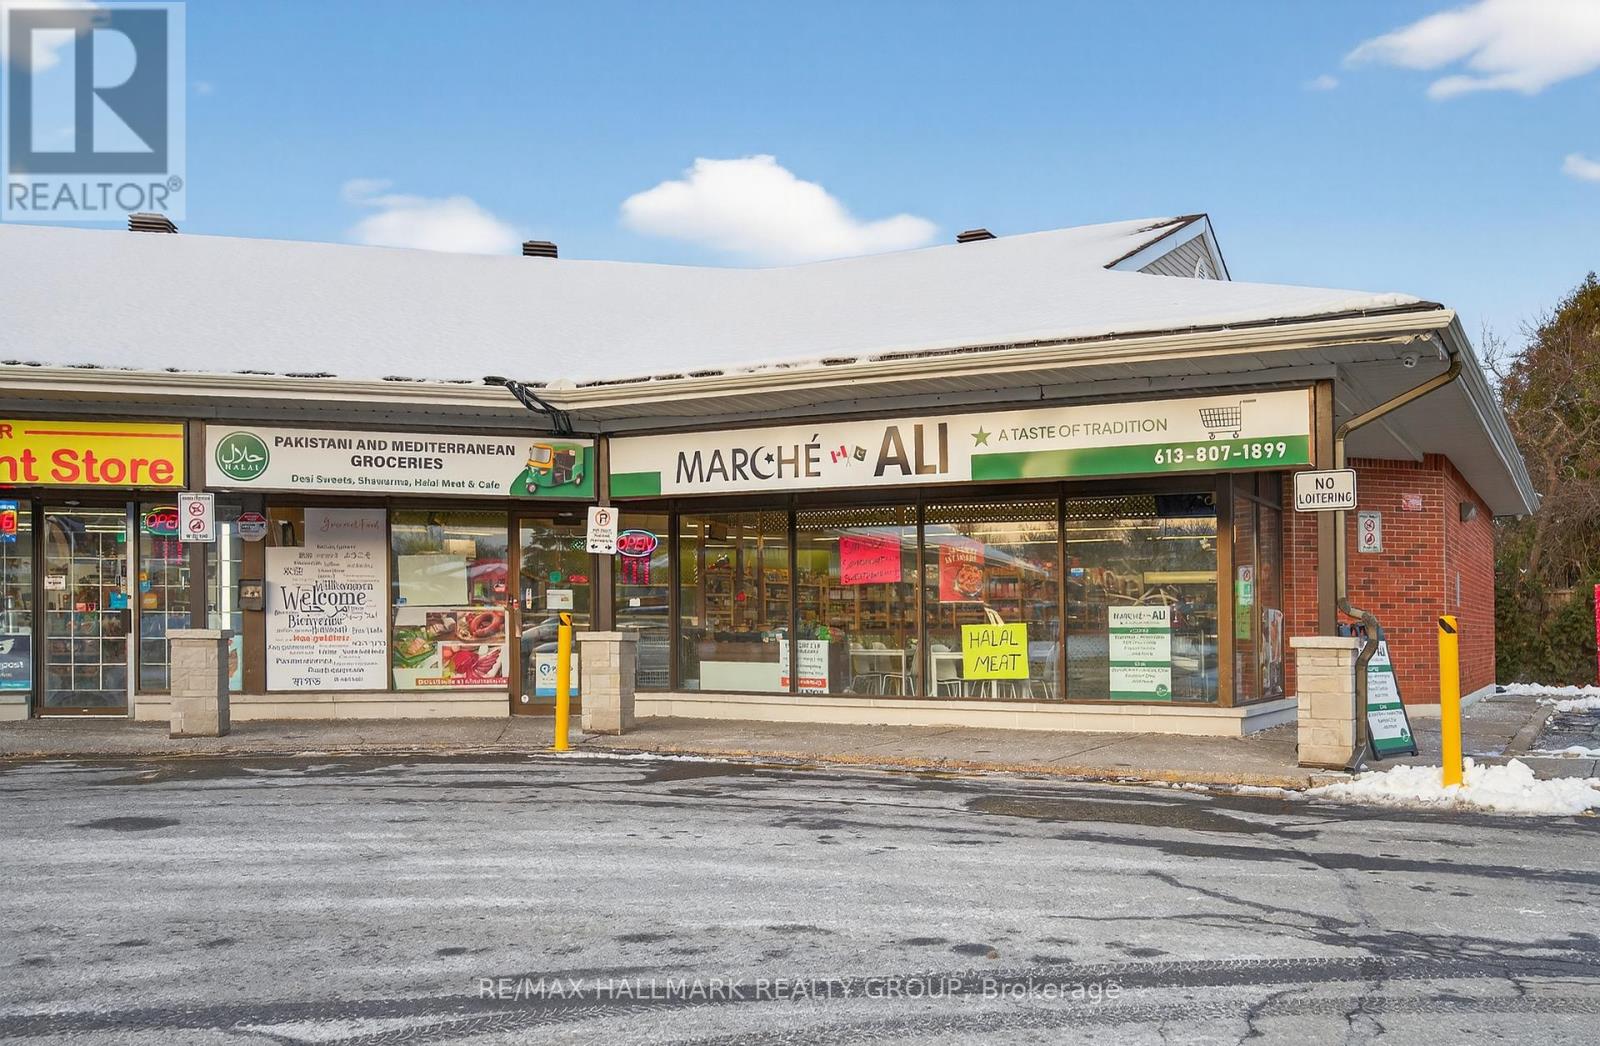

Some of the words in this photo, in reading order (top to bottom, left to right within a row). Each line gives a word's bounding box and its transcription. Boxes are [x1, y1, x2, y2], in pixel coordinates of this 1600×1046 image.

[998, 429, 1009, 441] A
[1010, 426, 1056, 441] TASTE
[1058, 424, 1081, 438] OF
[1083, 418, 1168, 436] TRADITION
[274, 436, 353, 450] PAKISTANI
[356, 438, 389, 451] AND
[391, 440, 516, 456] MEDITERRANEAN
[874, 422, 948, 477] ALI
[1154, 442, 1288, 465] 613-807-1899
[50, 449, 174, 483] Store
[350, 455, 444, 470] GROCERIES
[676, 433, 821, 483] MARCHÉ
[291, 474, 314, 483] Desi
[1315, 477, 1335, 490] NO
[1299, 492, 1352, 504] LOITERING
[618, 535, 654, 552] OPEN
[280, 585, 366, 610] Welcome
[969, 630, 1019, 649] HALAL
[973, 654, 1021, 673] MEAT
